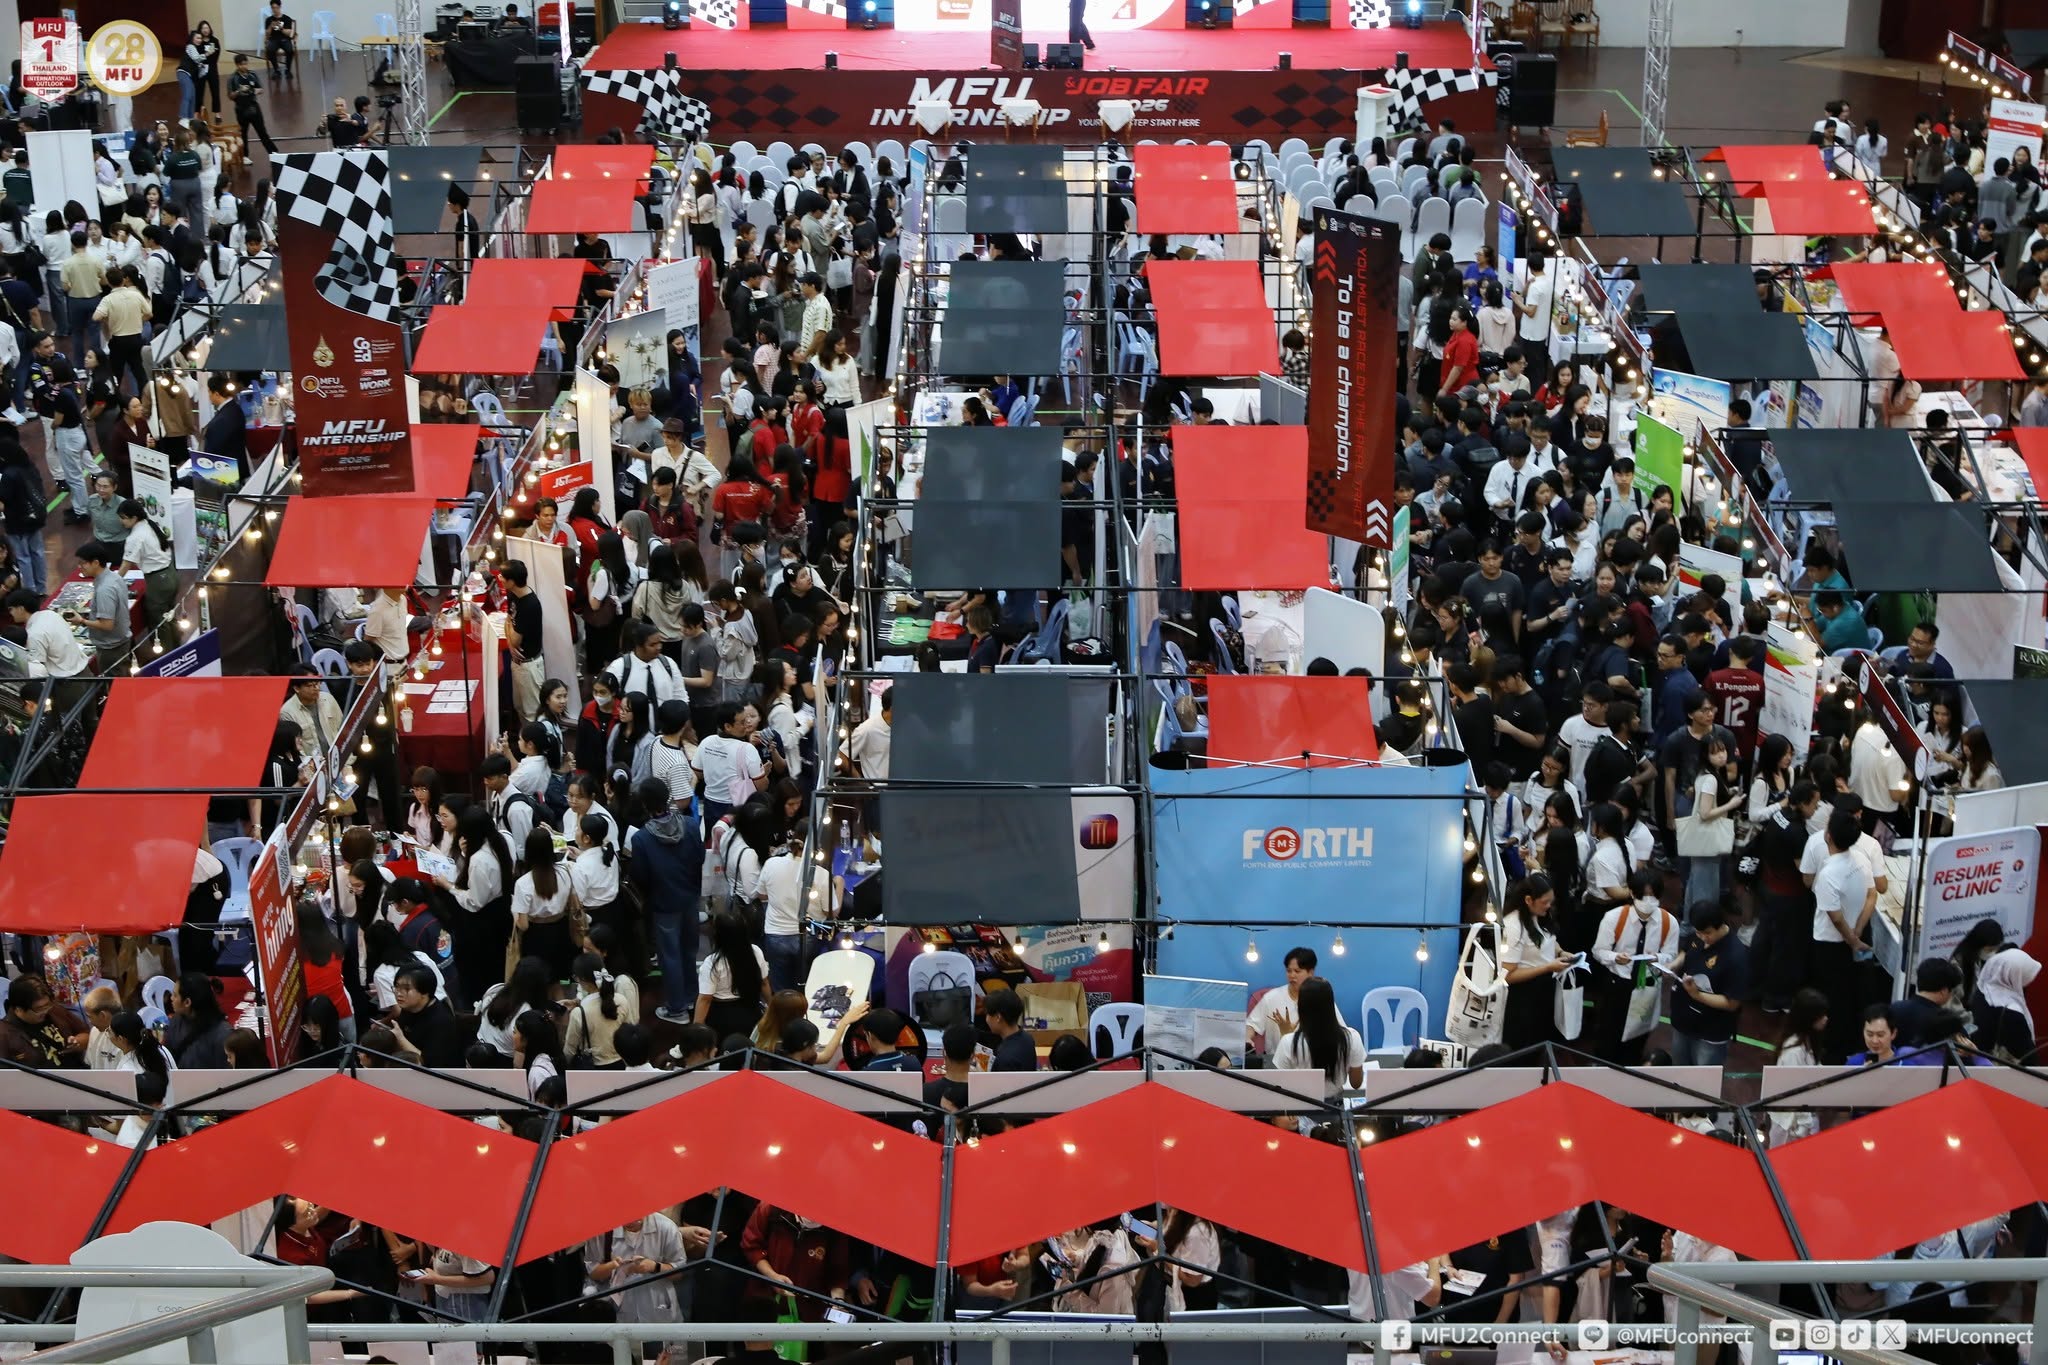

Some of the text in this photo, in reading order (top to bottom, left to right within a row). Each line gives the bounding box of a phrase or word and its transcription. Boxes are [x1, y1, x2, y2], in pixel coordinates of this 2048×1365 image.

[907, 77, 1033, 106] MFU
[1133, 78, 1210, 95] FAIR
[1150, 119, 1177, 127] START
[1178, 119, 1201, 127] HERE
[1338, 274, 1353, 304] To
[1356, 284, 1368, 327] MUST
[1338, 310, 1353, 339] be
[1338, 348, 1350, 361] a
[1356, 330, 1367, 373] RACE
[303, 431, 407, 446] INTERNSHIP
[322, 419, 386, 435] MFU
[339, 456, 372, 464] 2026
[1724, 695, 1750, 727] 12
[1243, 827, 1373, 860] FORTH
[1269, 839, 1297, 849] EMS
[1243, 861, 1267, 869] FORTH
[1308, 860, 1342, 868] COMPANY
[1933, 861, 2004, 886] RESUME
[1942, 878, 2002, 901] CLINIC
[264, 895, 295, 971] hiring
